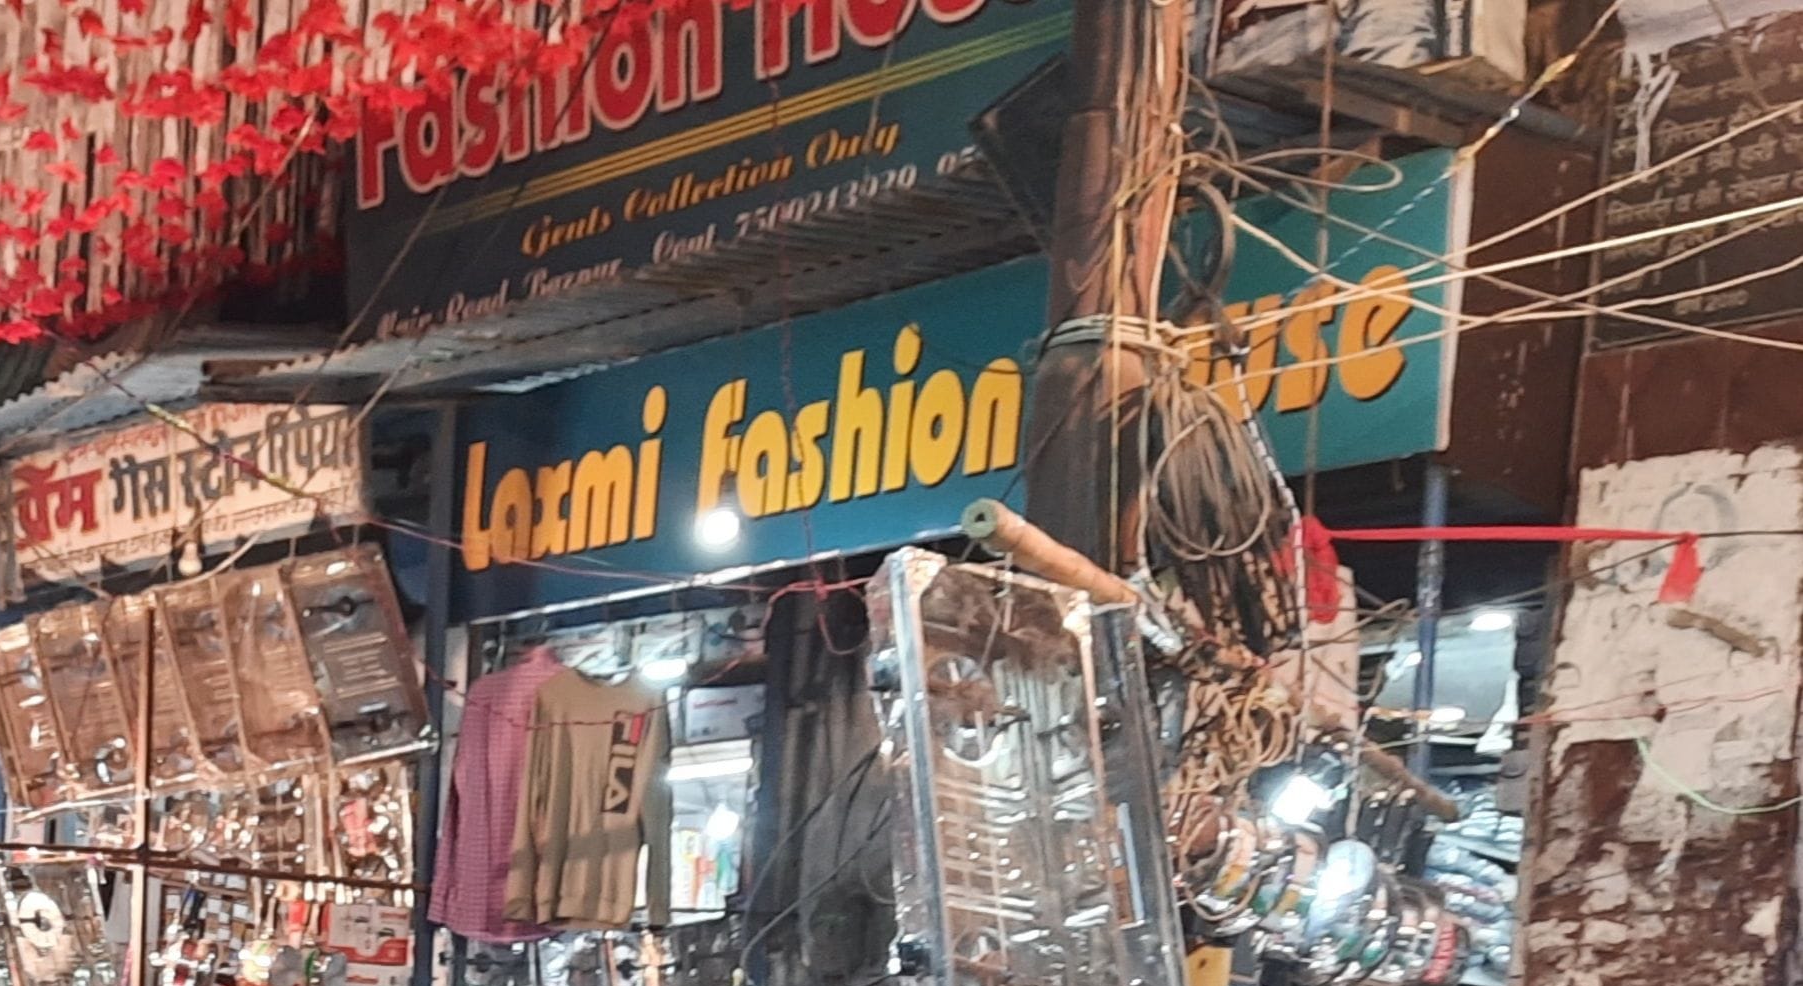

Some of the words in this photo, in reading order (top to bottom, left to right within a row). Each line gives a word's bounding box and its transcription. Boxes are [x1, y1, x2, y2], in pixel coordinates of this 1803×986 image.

[521, 206, 613, 257] Gents
[624, 154, 794, 218] Collection
[462, 385, 665, 572] Laxmi
[697, 322, 1024, 534] Fashion
[1193, 265, 1413, 424] use
[601, 709, 647, 813] FILA
